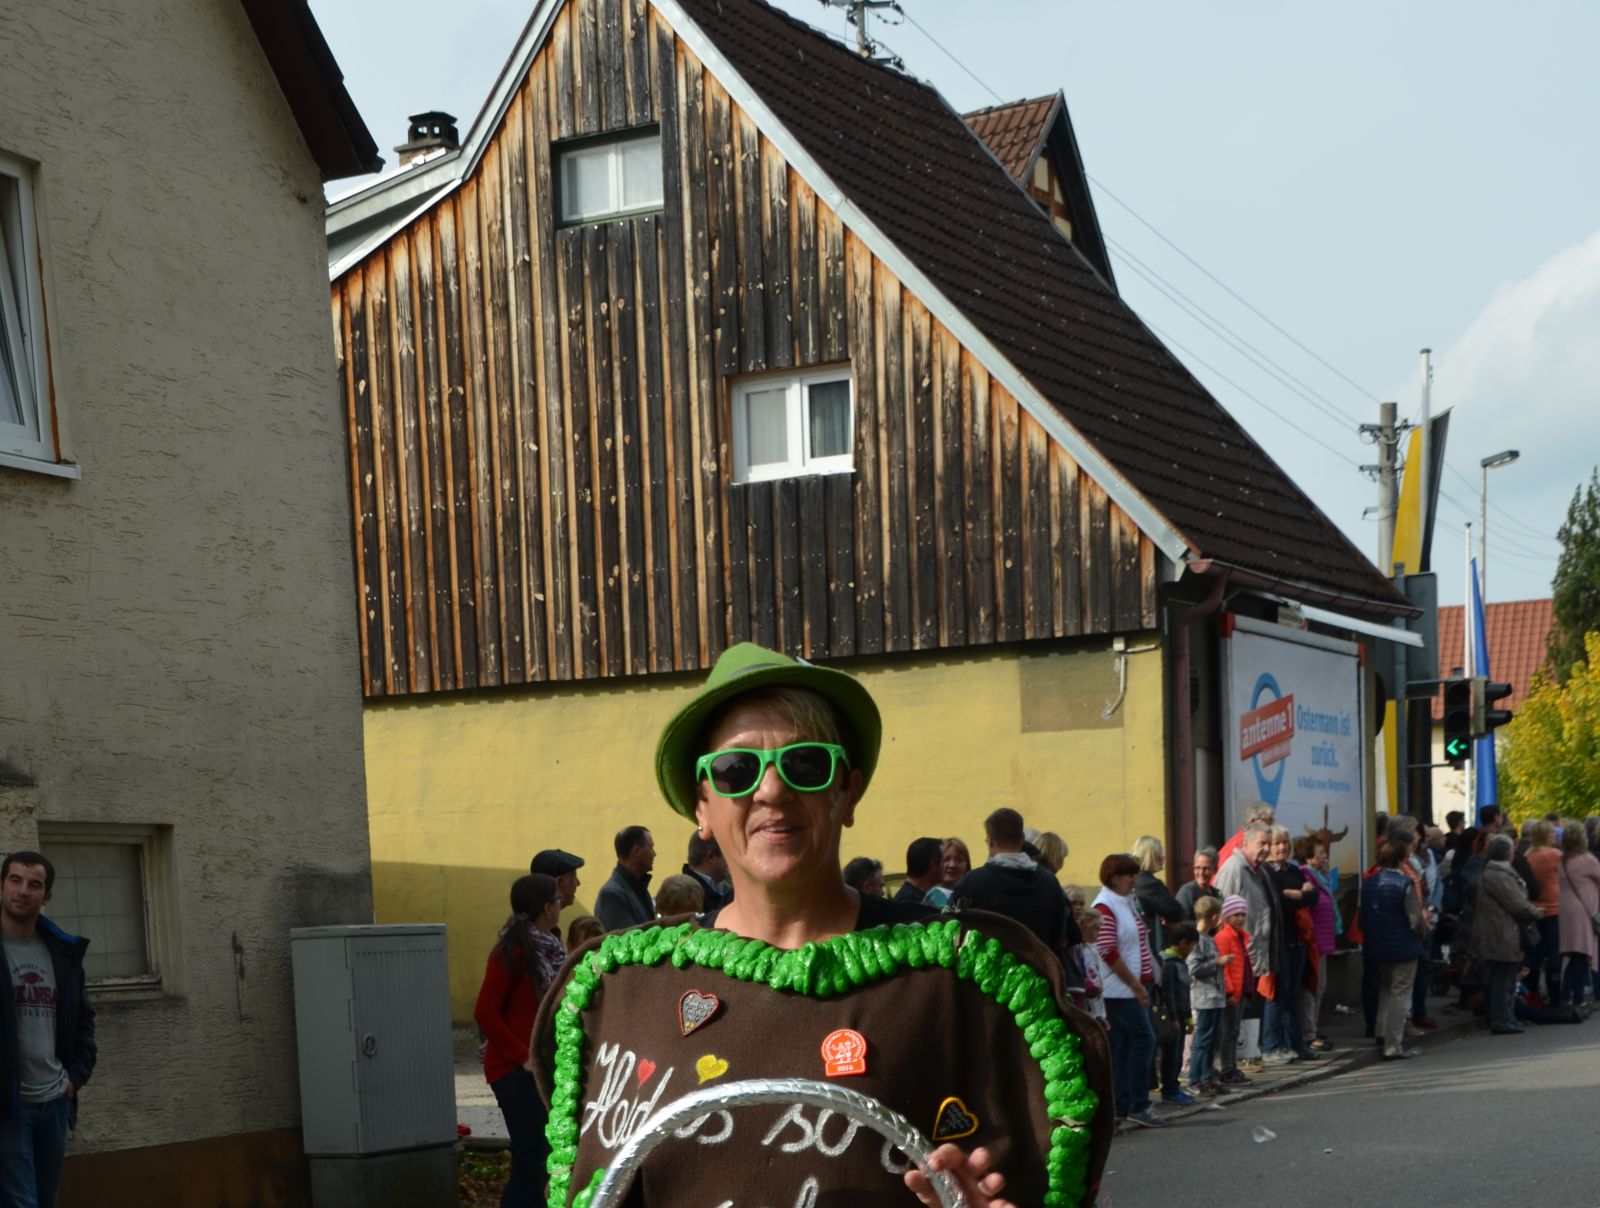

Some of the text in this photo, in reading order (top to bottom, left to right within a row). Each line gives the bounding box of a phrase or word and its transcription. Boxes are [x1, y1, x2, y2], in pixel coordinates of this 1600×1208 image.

[1242, 711, 1287, 749] antenne
[1296, 703, 1351, 737] Ostermann ist
[837, 1064, 855, 1072] 2016
[760, 1102, 864, 1157] so
